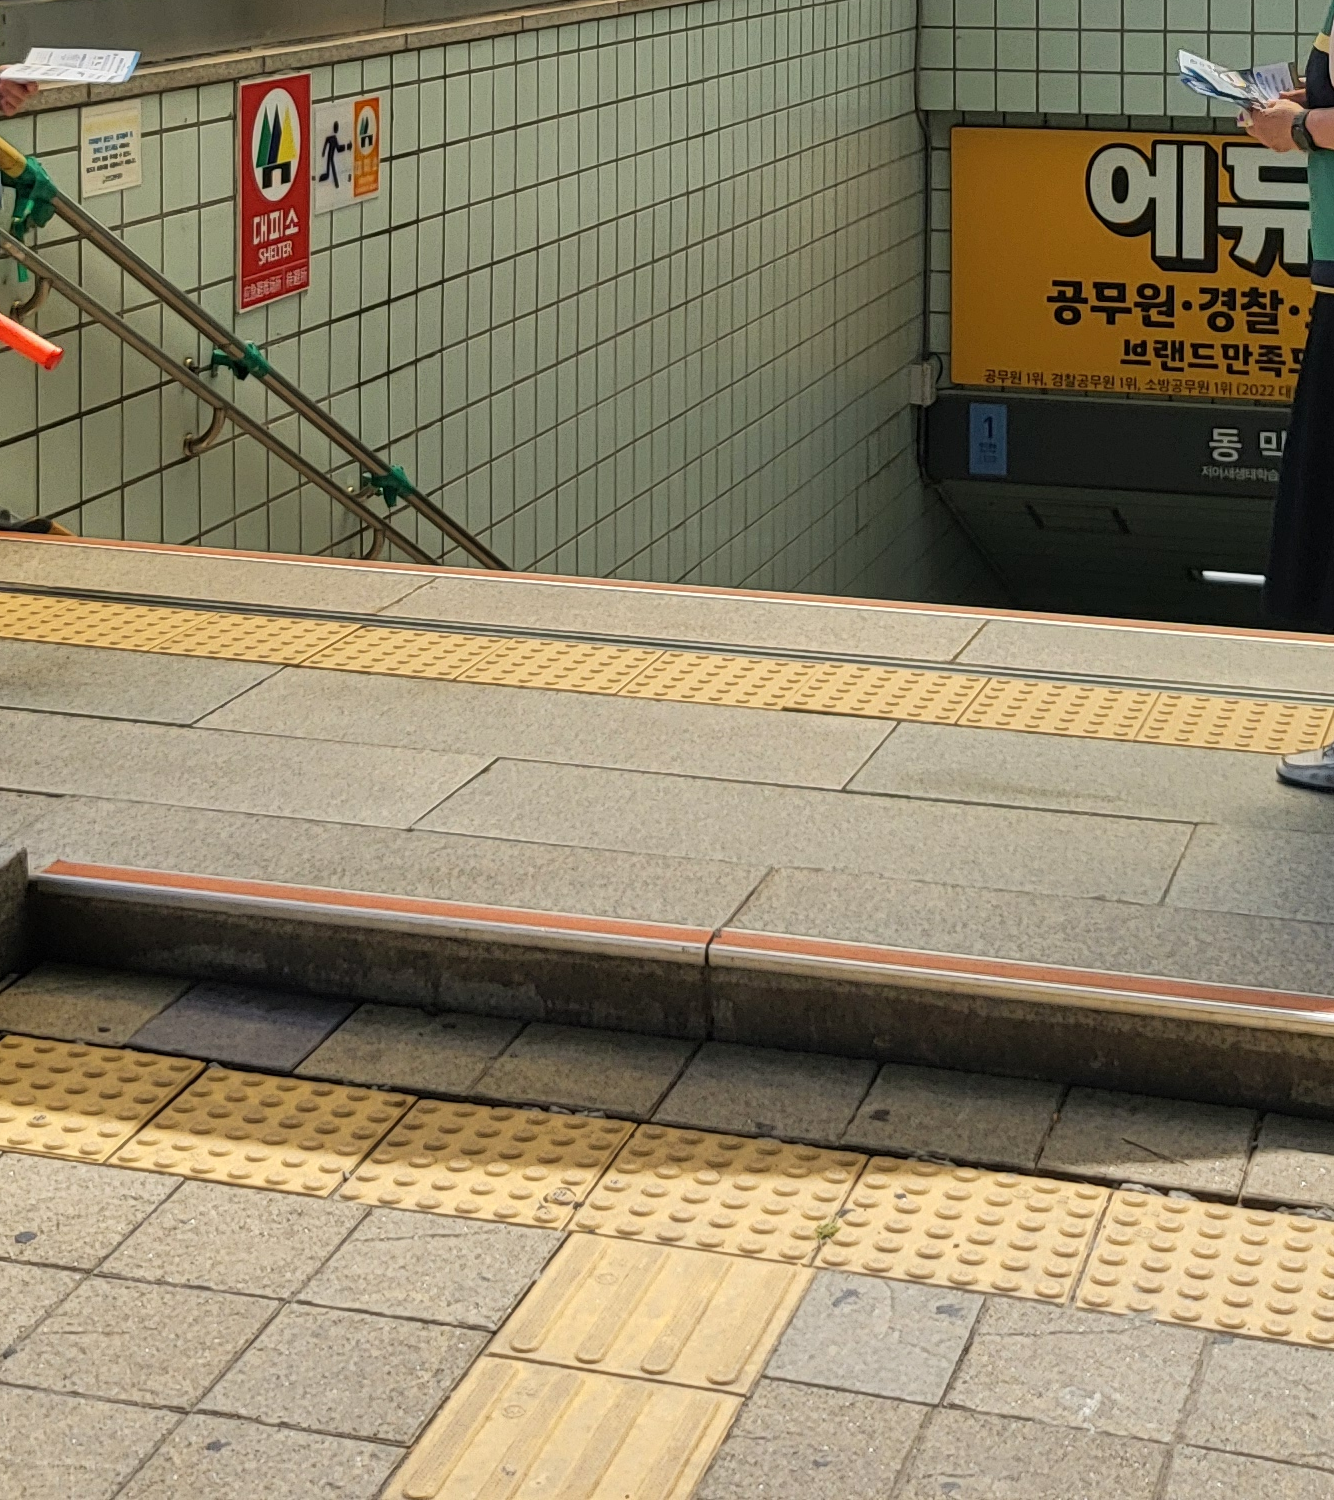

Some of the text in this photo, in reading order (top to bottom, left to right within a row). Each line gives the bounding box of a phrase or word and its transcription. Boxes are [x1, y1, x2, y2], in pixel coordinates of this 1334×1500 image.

[252, 207, 300, 245] 대피소
[257, 240, 292, 265] SHELTER
[983, 369, 1022, 386] 공무원
[1051, 372, 1115, 390] 경찰공무원
[1144, 377, 1210, 394] 소방공무원
[1214, 380, 1232, 396] 1위
[1236, 381, 1275, 398] (2022
[982, 416, 993, 439] 1
